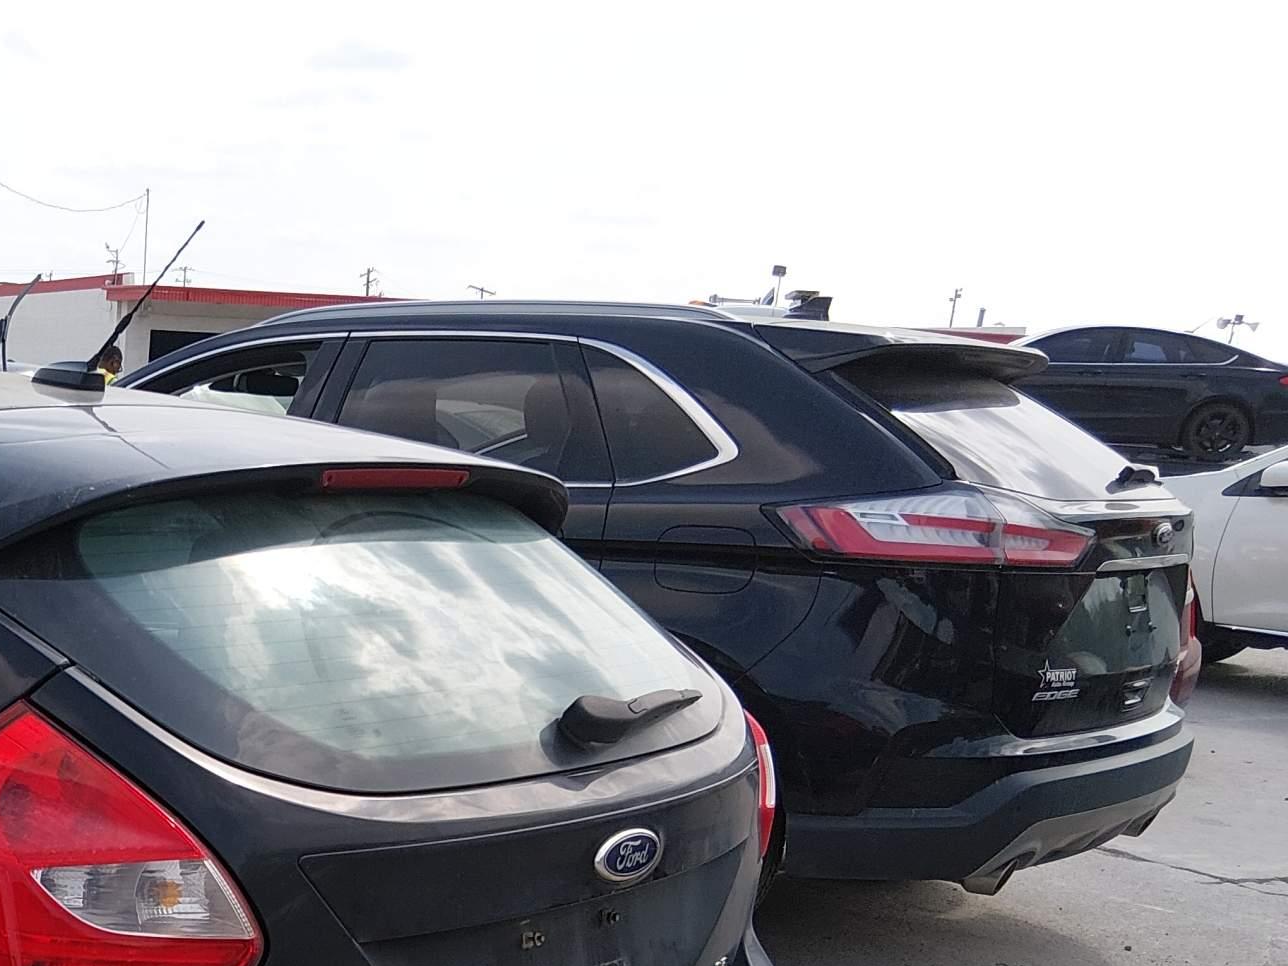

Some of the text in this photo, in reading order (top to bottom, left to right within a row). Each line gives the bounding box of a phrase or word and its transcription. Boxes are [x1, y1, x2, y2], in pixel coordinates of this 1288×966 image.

[1045, 670, 1077, 682] PATRIOT
[1031, 688, 1081, 701] EDGE
[616, 839, 650, 871] Ford
